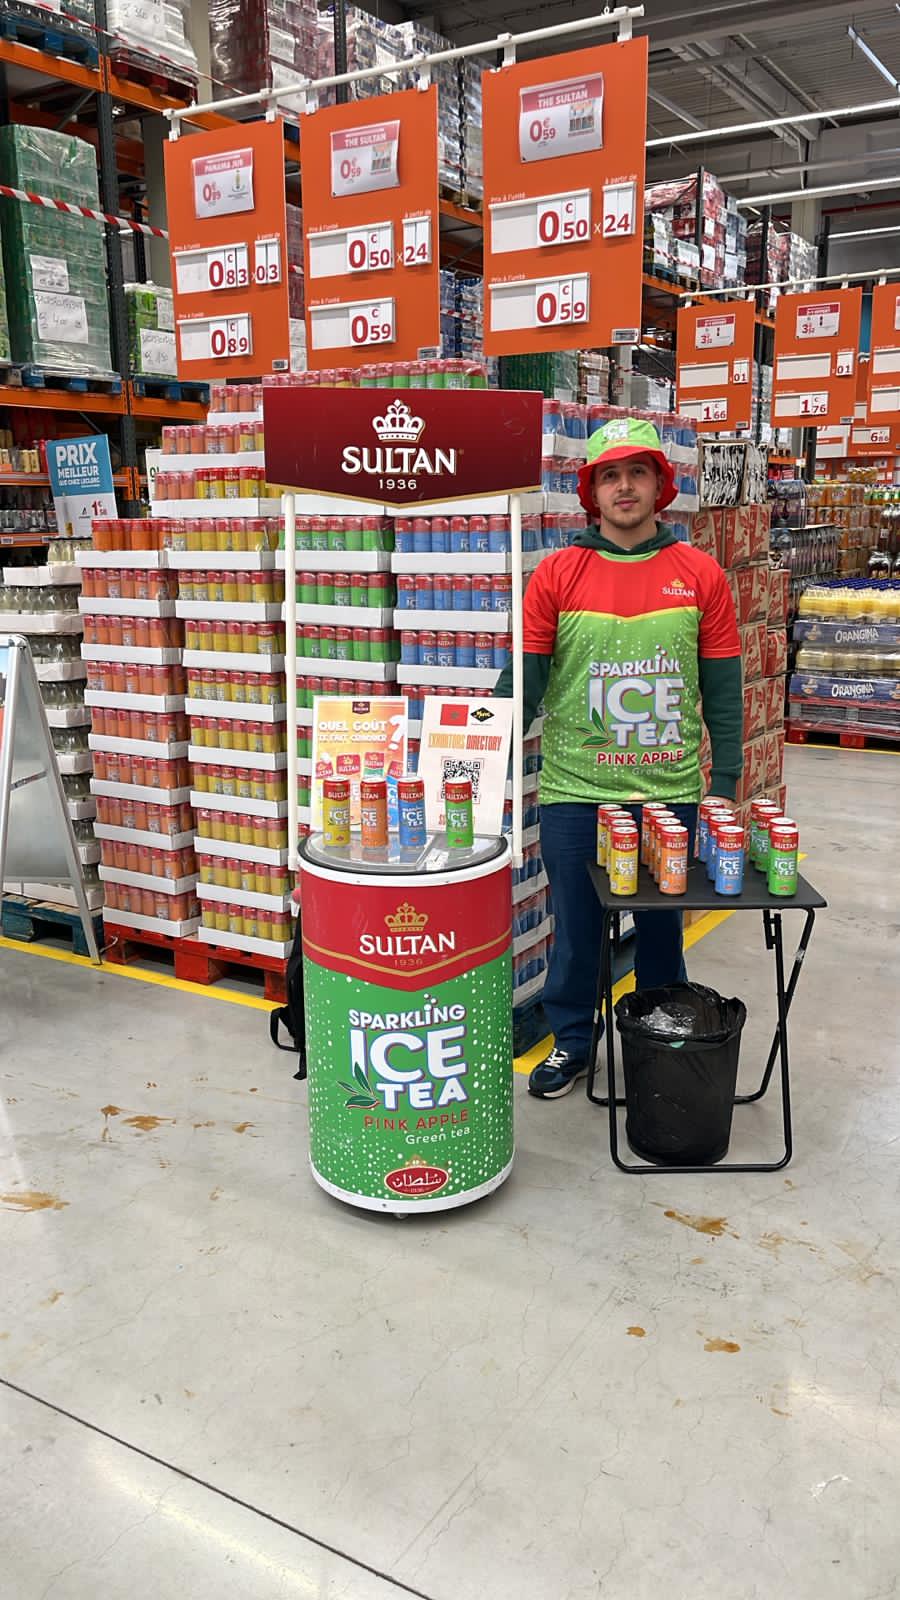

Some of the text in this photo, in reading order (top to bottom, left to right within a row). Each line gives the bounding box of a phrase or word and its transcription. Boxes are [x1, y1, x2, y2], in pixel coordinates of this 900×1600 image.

[555, 90, 588, 106] SULTAN
[359, 133, 386, 145] SULTAN
[204, 160, 232, 173] PANAMA
[604, 213, 630, 233] 24
[405, 243, 428, 263] 24
[56, 442, 98, 467] PRIX
[341, 446, 456, 475] SULTAN
[58, 466, 99, 478] MEILLEUR
[378, 479, 417, 490] 1936
[662, 586, 695, 597] SULTAN
[835, 627, 880, 643] ORANGINA
[832, 682, 875, 697] ORANGINA
[589, 678, 684, 723] ICE
[319, 721, 349, 732] QUEL
[352, 719, 387, 732] GOÛT
[428, 732, 502, 751] EXHIBITORS DIRECTORY
[610, 722, 683, 747] TEA
[596, 749, 684, 766] PINK APPLE
[632, 767, 665, 776] Green
[401, 792, 424, 800] SULTAN
[447, 792, 469, 800] SULTAN
[402, 810, 424, 821] ICE
[447, 812, 468, 822] ICE
[615, 861, 635, 869] ICE
[667, 860, 687, 869] ICE
[719, 860, 740, 870] ICE
[775, 861, 795, 871] ICE
[360, 931, 455, 956] SULTAN
[394, 958, 423, 968] 1936
[349, 1003, 466, 1030] SPARKLING
[350, 1025, 467, 1083] ICE
[376, 1077, 468, 1110] TEA
[364, 1109, 469, 1131] PINK APPLE
[405, 1126, 471, 1145] Green tea
[391, 1171, 442, 1188] سلطان
